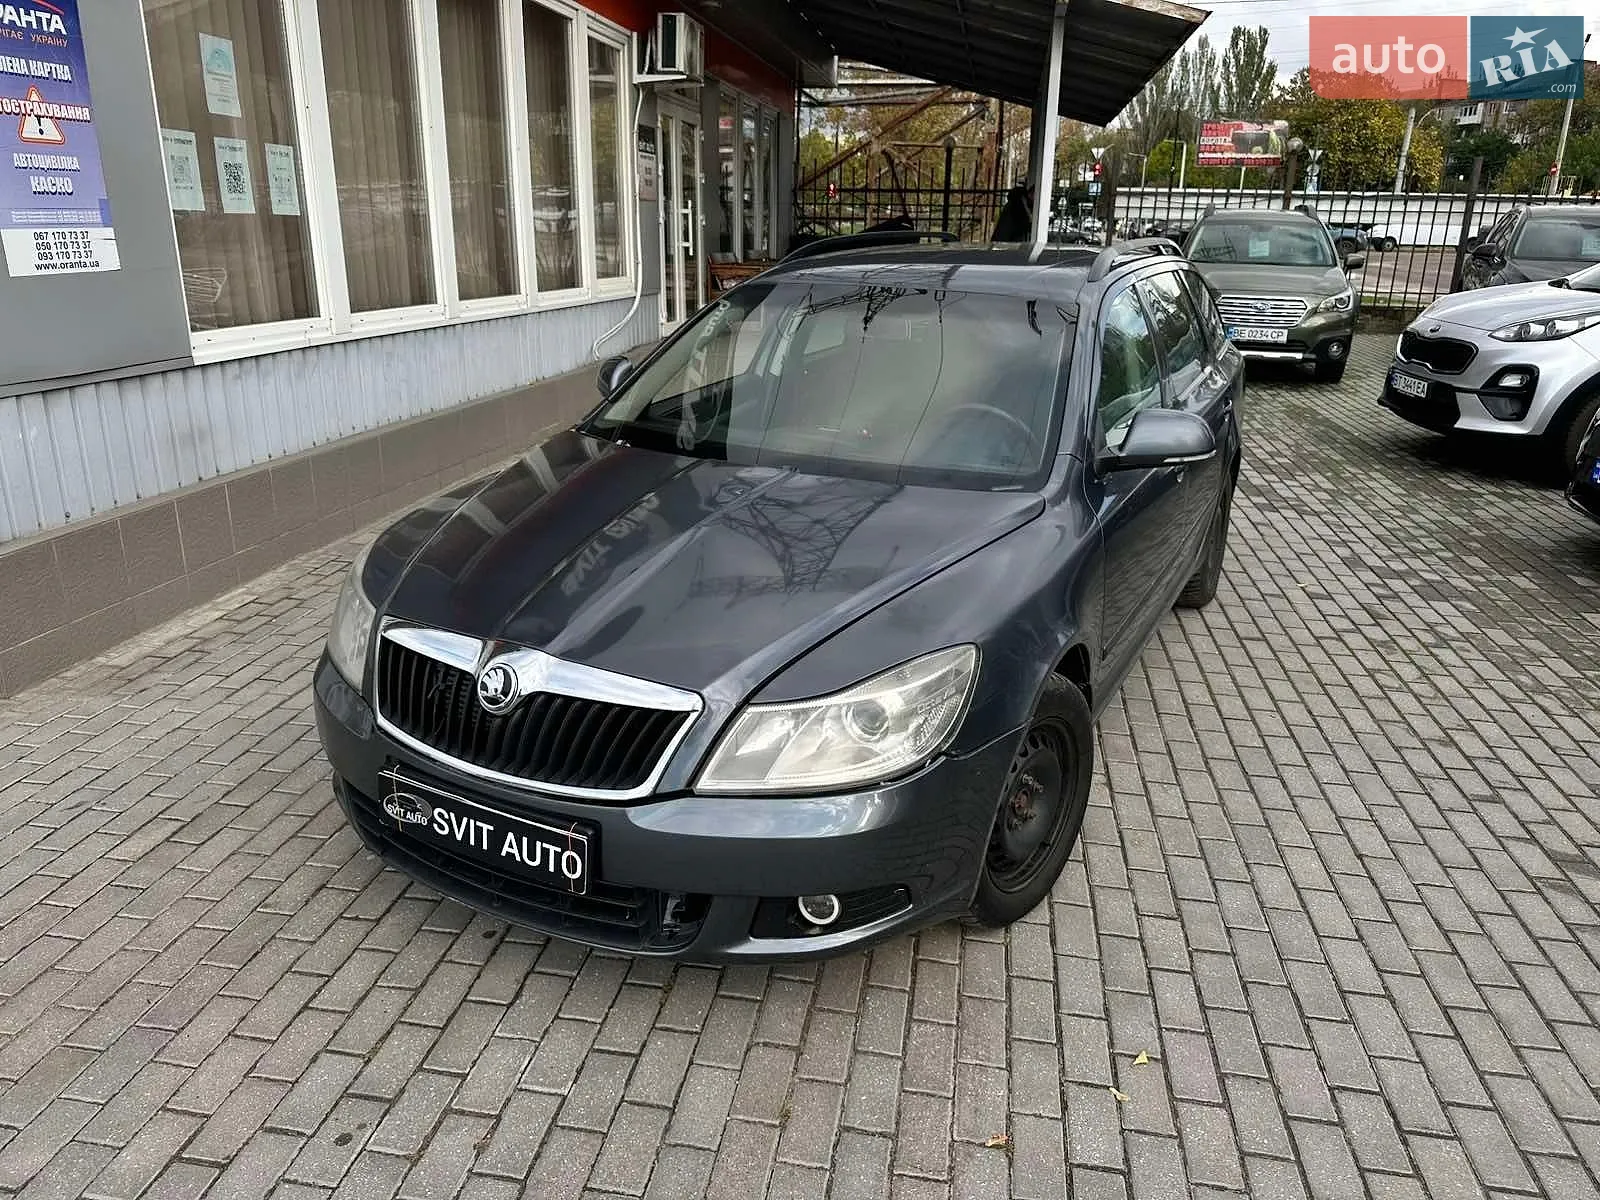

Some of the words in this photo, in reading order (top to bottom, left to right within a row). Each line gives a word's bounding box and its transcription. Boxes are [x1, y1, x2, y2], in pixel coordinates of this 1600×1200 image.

[29, 59, 72, 82] КАРТКА
[30, 175, 74, 195] КАСКО
[34, 231, 48, 240] 067
[52, 231, 66, 240] 170
[68, 231, 78, 240] 73
[80, 231, 88, 240] 37
[36, 241, 51, 250] 050
[54, 241, 68, 250] 170
[70, 241, 80, 250] 73
[82, 241, 90, 250] 37
[38, 250, 53, 260] 093
[56, 250, 70, 260] 170
[72, 250, 82, 260] 73
[84, 250, 92, 260] 37
[34, 260, 100, 270] www.oranta.ua
[386, 804, 405, 817] SVIT
[406, 810, 428, 826] AUTO
[432, 807, 495, 850] SVIT
[500, 831, 583, 880] AUTO
